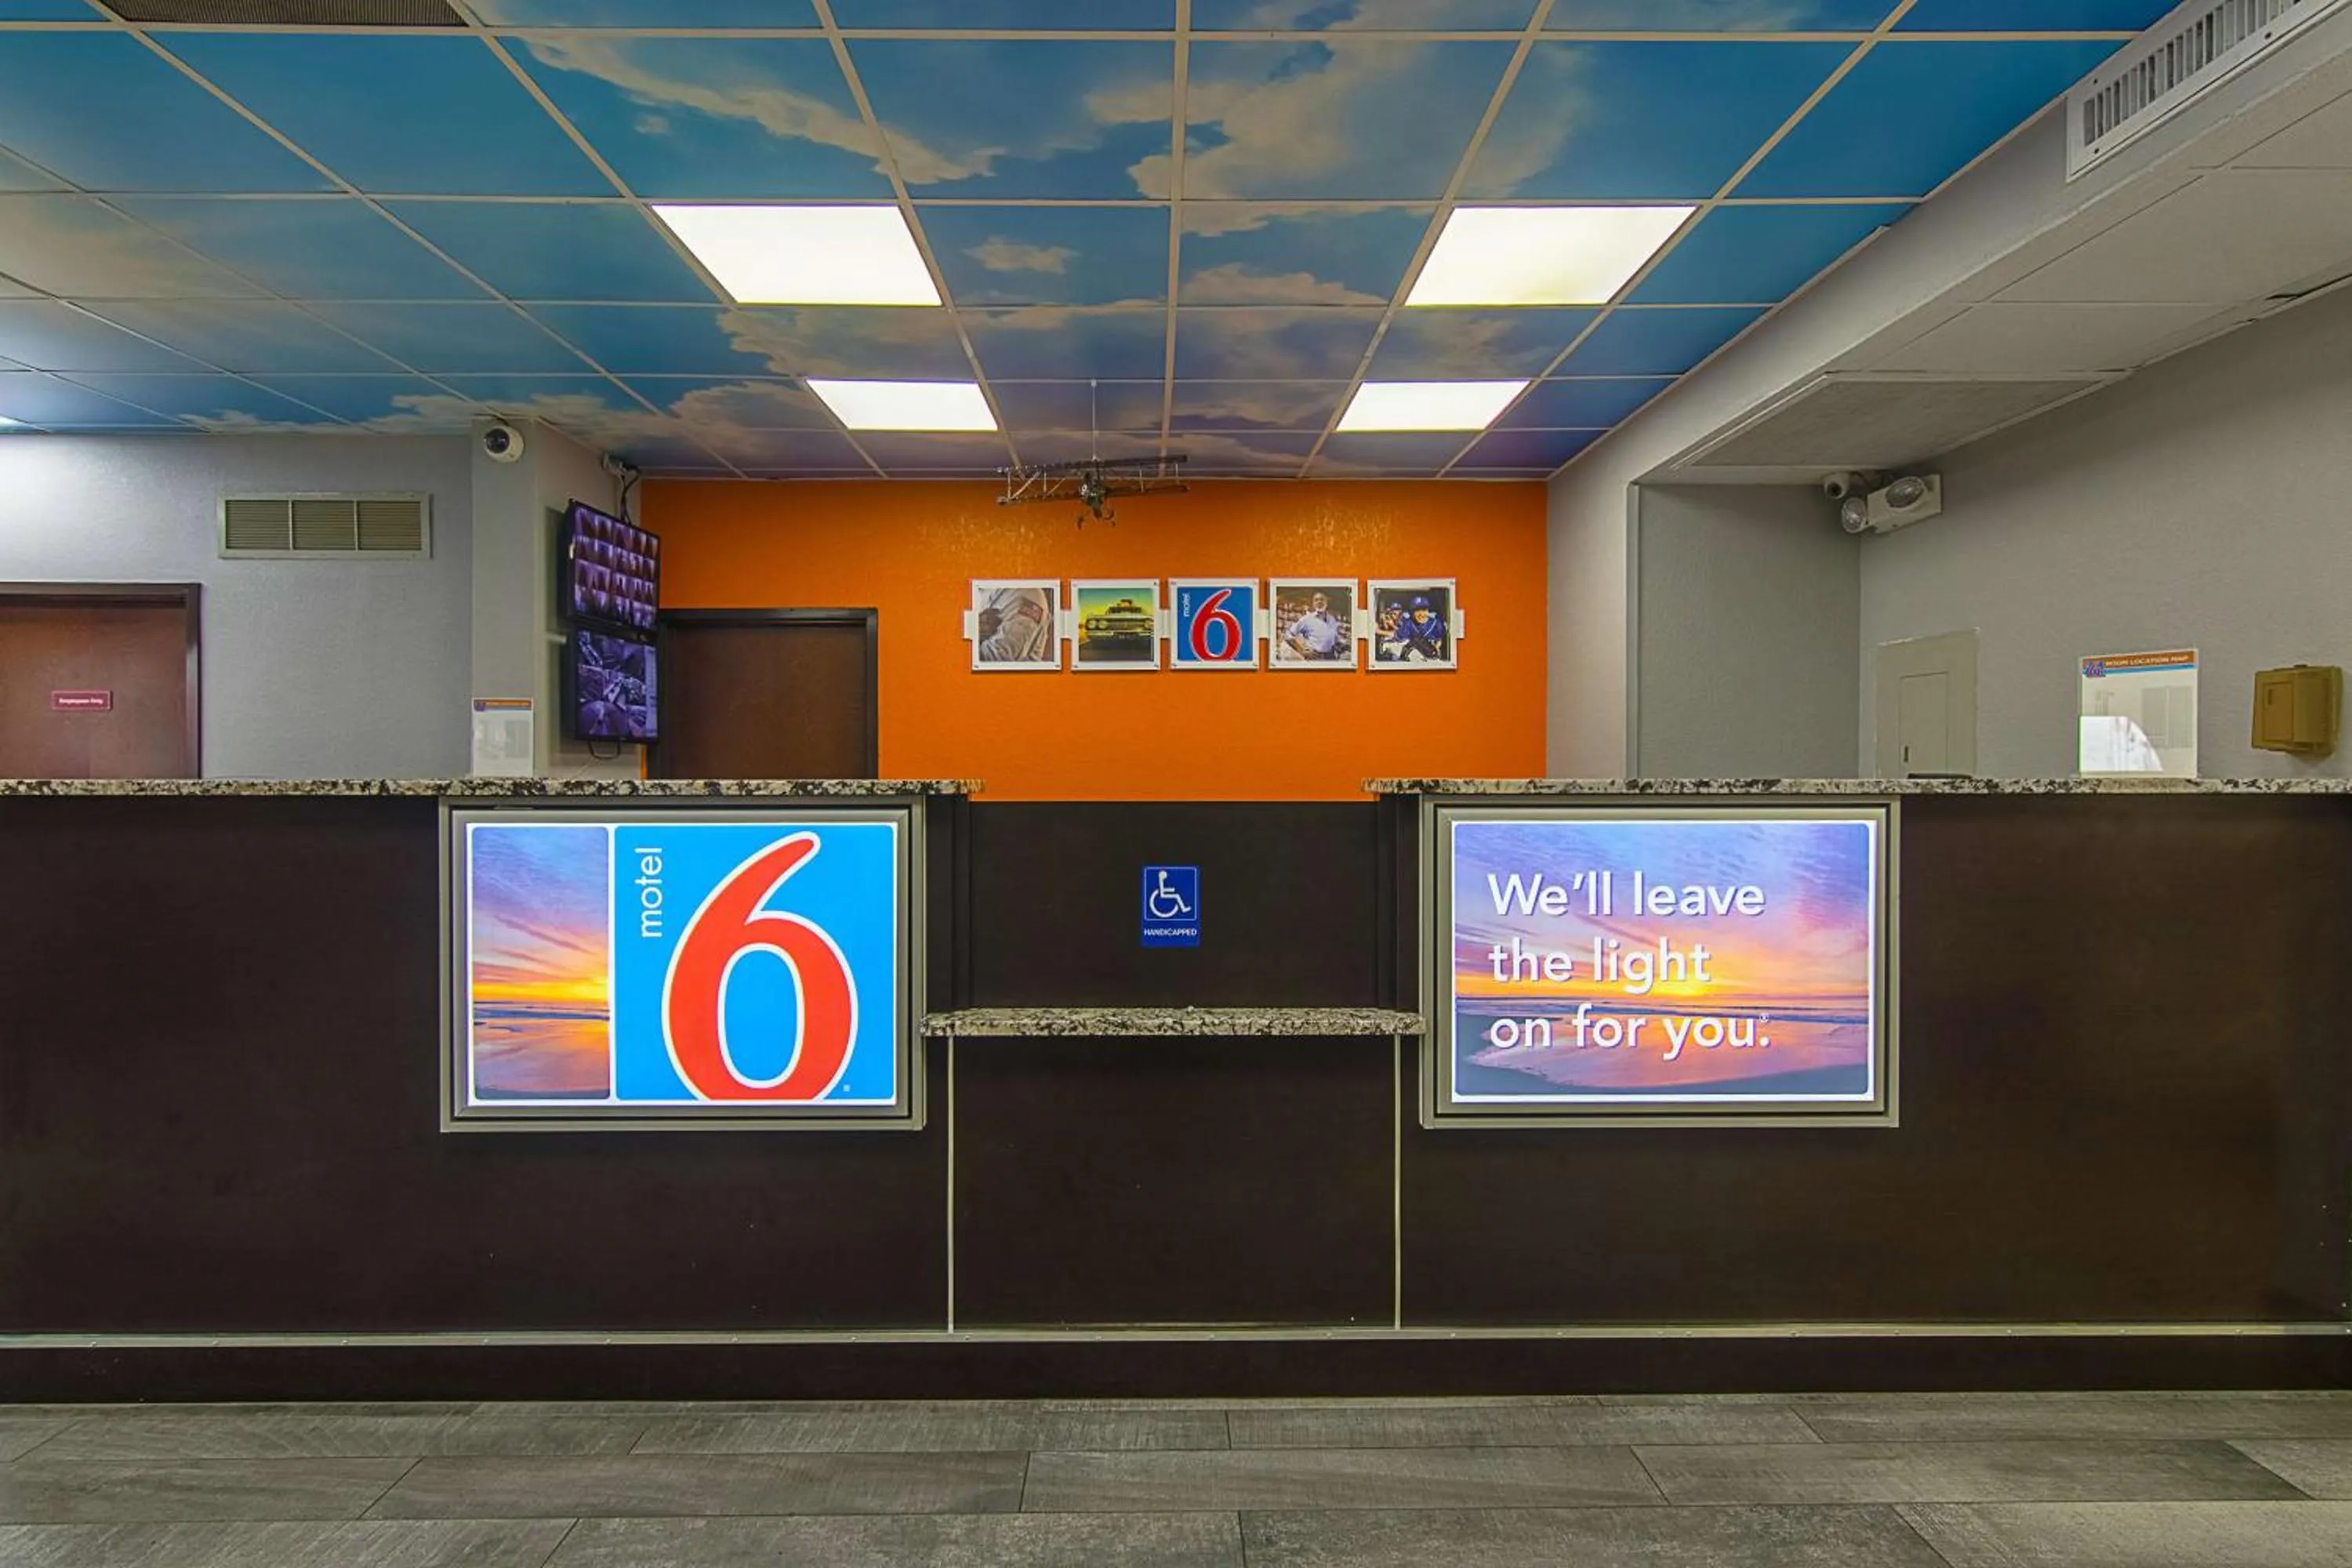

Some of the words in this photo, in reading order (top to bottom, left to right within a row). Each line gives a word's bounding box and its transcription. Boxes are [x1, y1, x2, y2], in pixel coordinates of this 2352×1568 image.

[1189, 588, 1242, 662] 6
[635, 847, 662, 938] motel
[1633, 871, 1766, 916] leave
[661, 831, 858, 1101] 6
[1488, 937, 1573, 983] the
[1594, 937, 1711, 994] light
[1490, 1018, 1552, 1048] on
[1573, 1004, 1646, 1048] for
